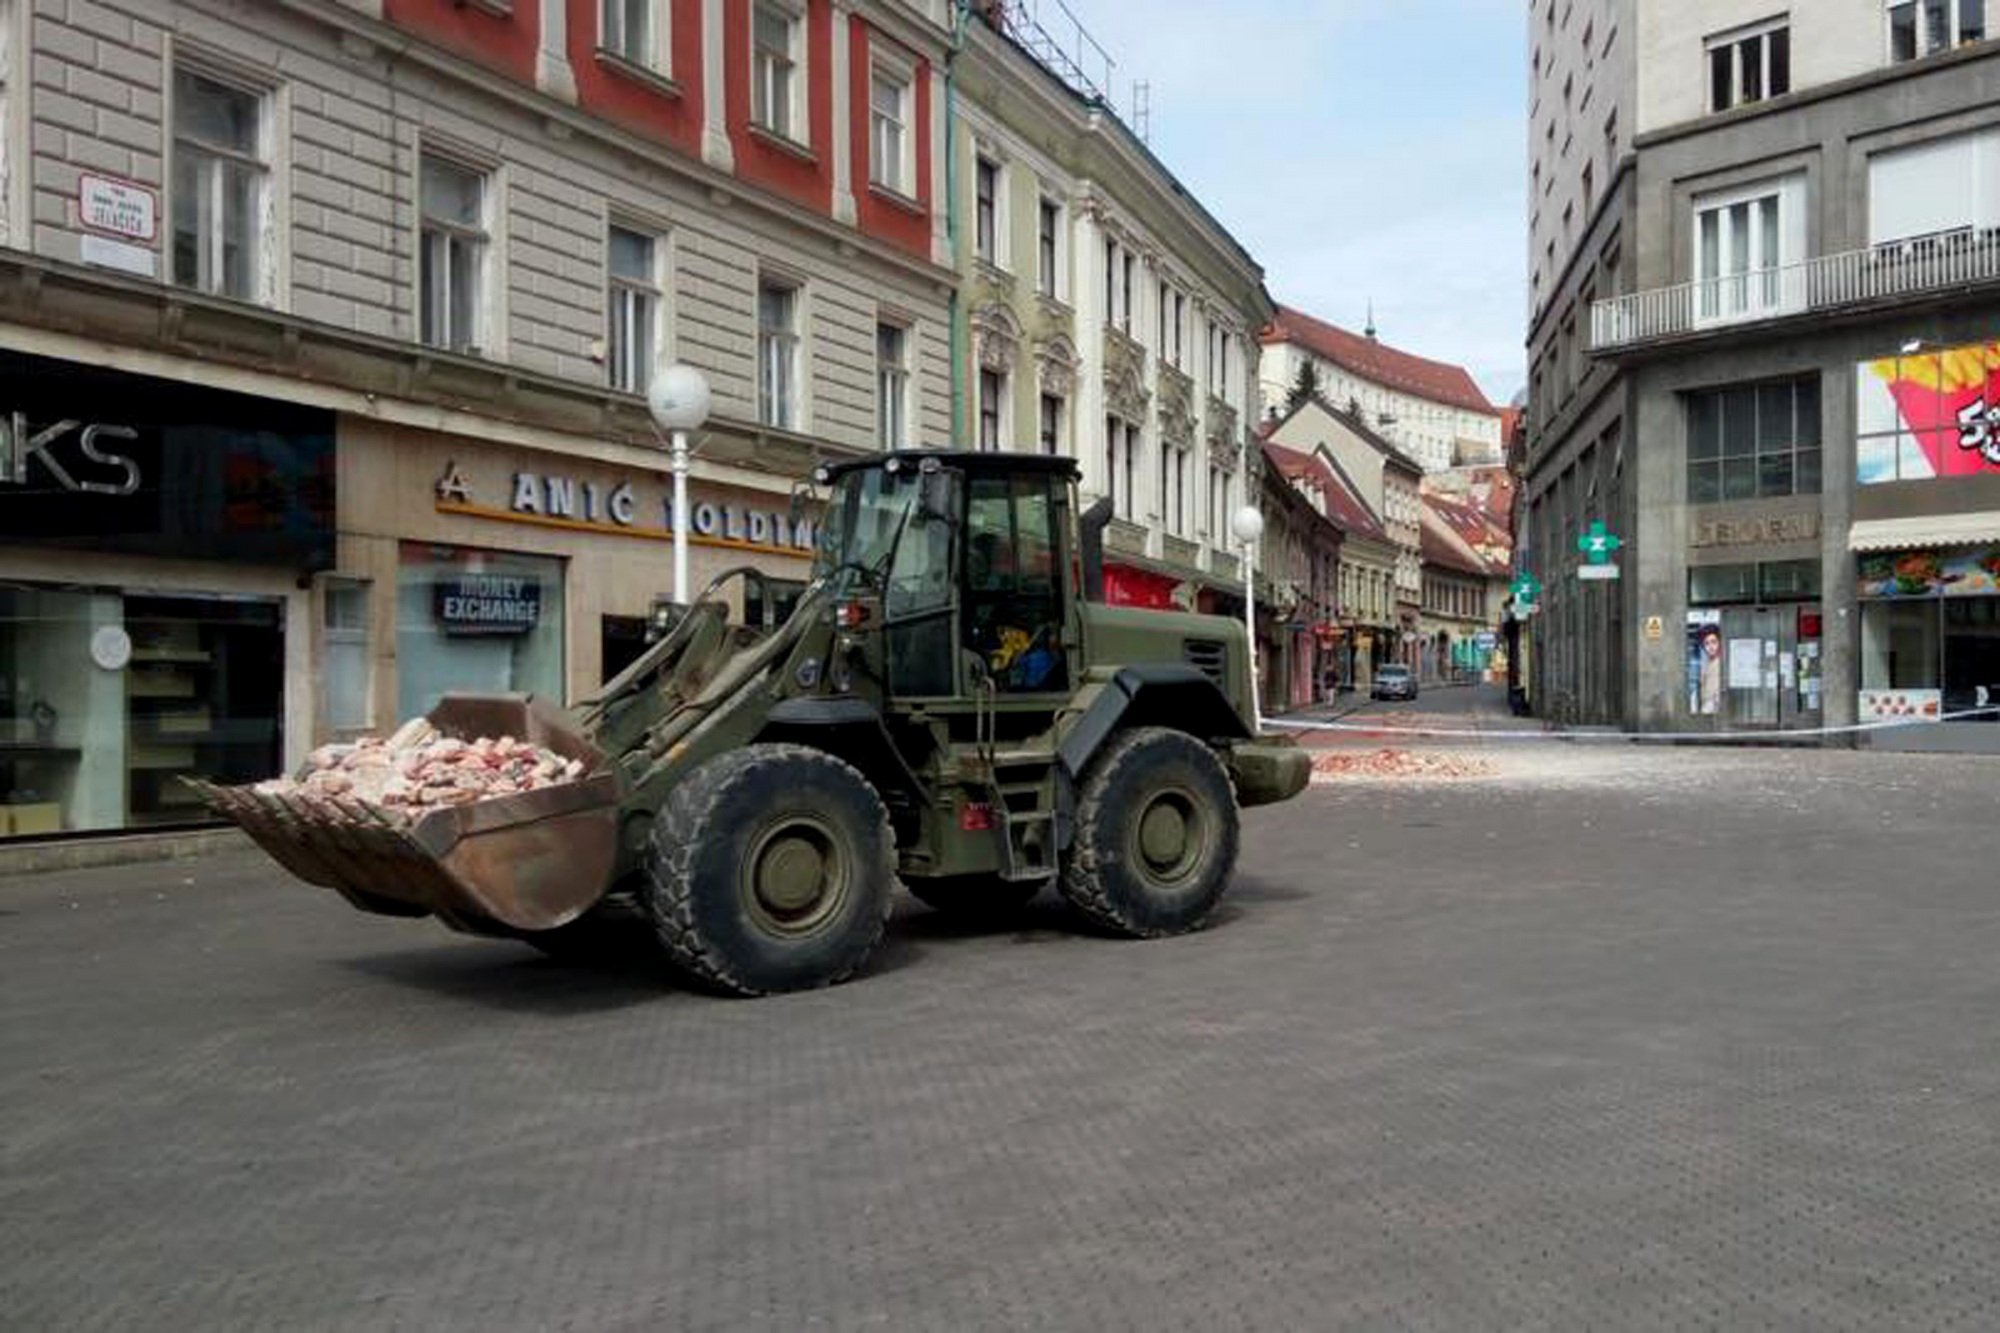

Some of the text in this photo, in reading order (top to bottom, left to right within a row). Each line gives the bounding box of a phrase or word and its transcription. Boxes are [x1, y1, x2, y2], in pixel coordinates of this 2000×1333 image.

[511, 471, 634, 525] ANIĆ
[459, 577, 524, 599] MONEY
[443, 597, 538, 621] EXCHANGE
